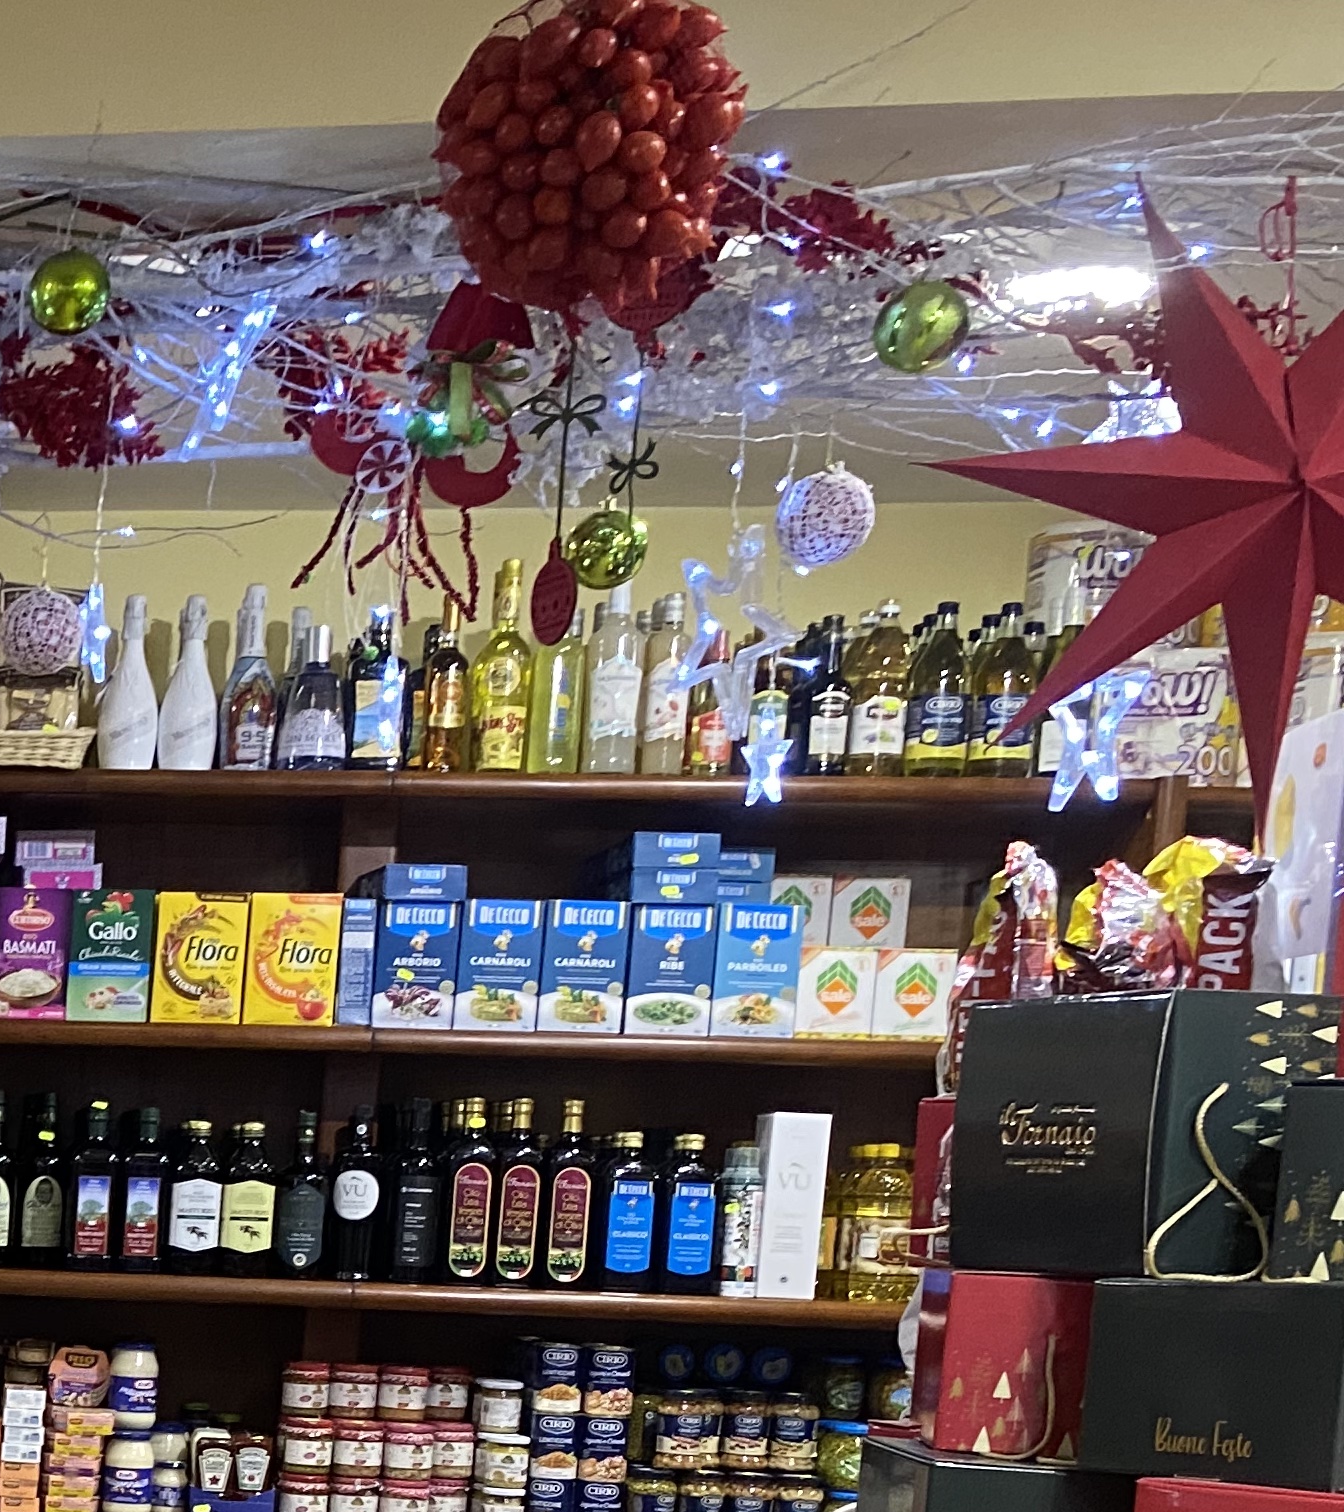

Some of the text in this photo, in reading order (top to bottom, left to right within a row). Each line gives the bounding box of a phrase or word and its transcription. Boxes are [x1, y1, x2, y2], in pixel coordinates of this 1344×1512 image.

[1177, 746, 1234, 775] 200
[396, 907, 445, 926] DE CECCO
[481, 907, 529, 926] DE CECCO
[564, 907, 614, 926] DE CECCO
[650, 907, 702, 929] DE CECCO
[736, 907, 786, 931] DE CECCO
[851, 912, 888, 929] sale
[89, 922, 137, 941] Gallo
[3, 940, 56, 955] BASMATI
[184, 936, 238, 963] Flora
[278, 939, 332, 965] Flora
[393, 957, 441, 967] ARBORIO
[470, 956, 531, 967] CARNAROLI
[554, 957, 616, 969] CARNAROLI
[658, 959, 686, 971] RIBE
[726, 961, 788, 973] PARBOILED
[819, 989, 856, 1004] sale
[898, 990, 933, 1006] sale
[1002, 1103, 1097, 1147] Fornaio
[343, 1183, 367, 1197] VU
[546, 1352, 576, 1361] CIRIO
[596, 1355, 625, 1365] CIRIO
[543, 1420, 573, 1429] CIRIO
[591, 1423, 621, 1432] CIRIO
[1154, 1417, 1253, 1459] Buone Feste
[533, 1484, 561, 1493] CIRIO
[587, 1487, 616, 1496] CIRIO
